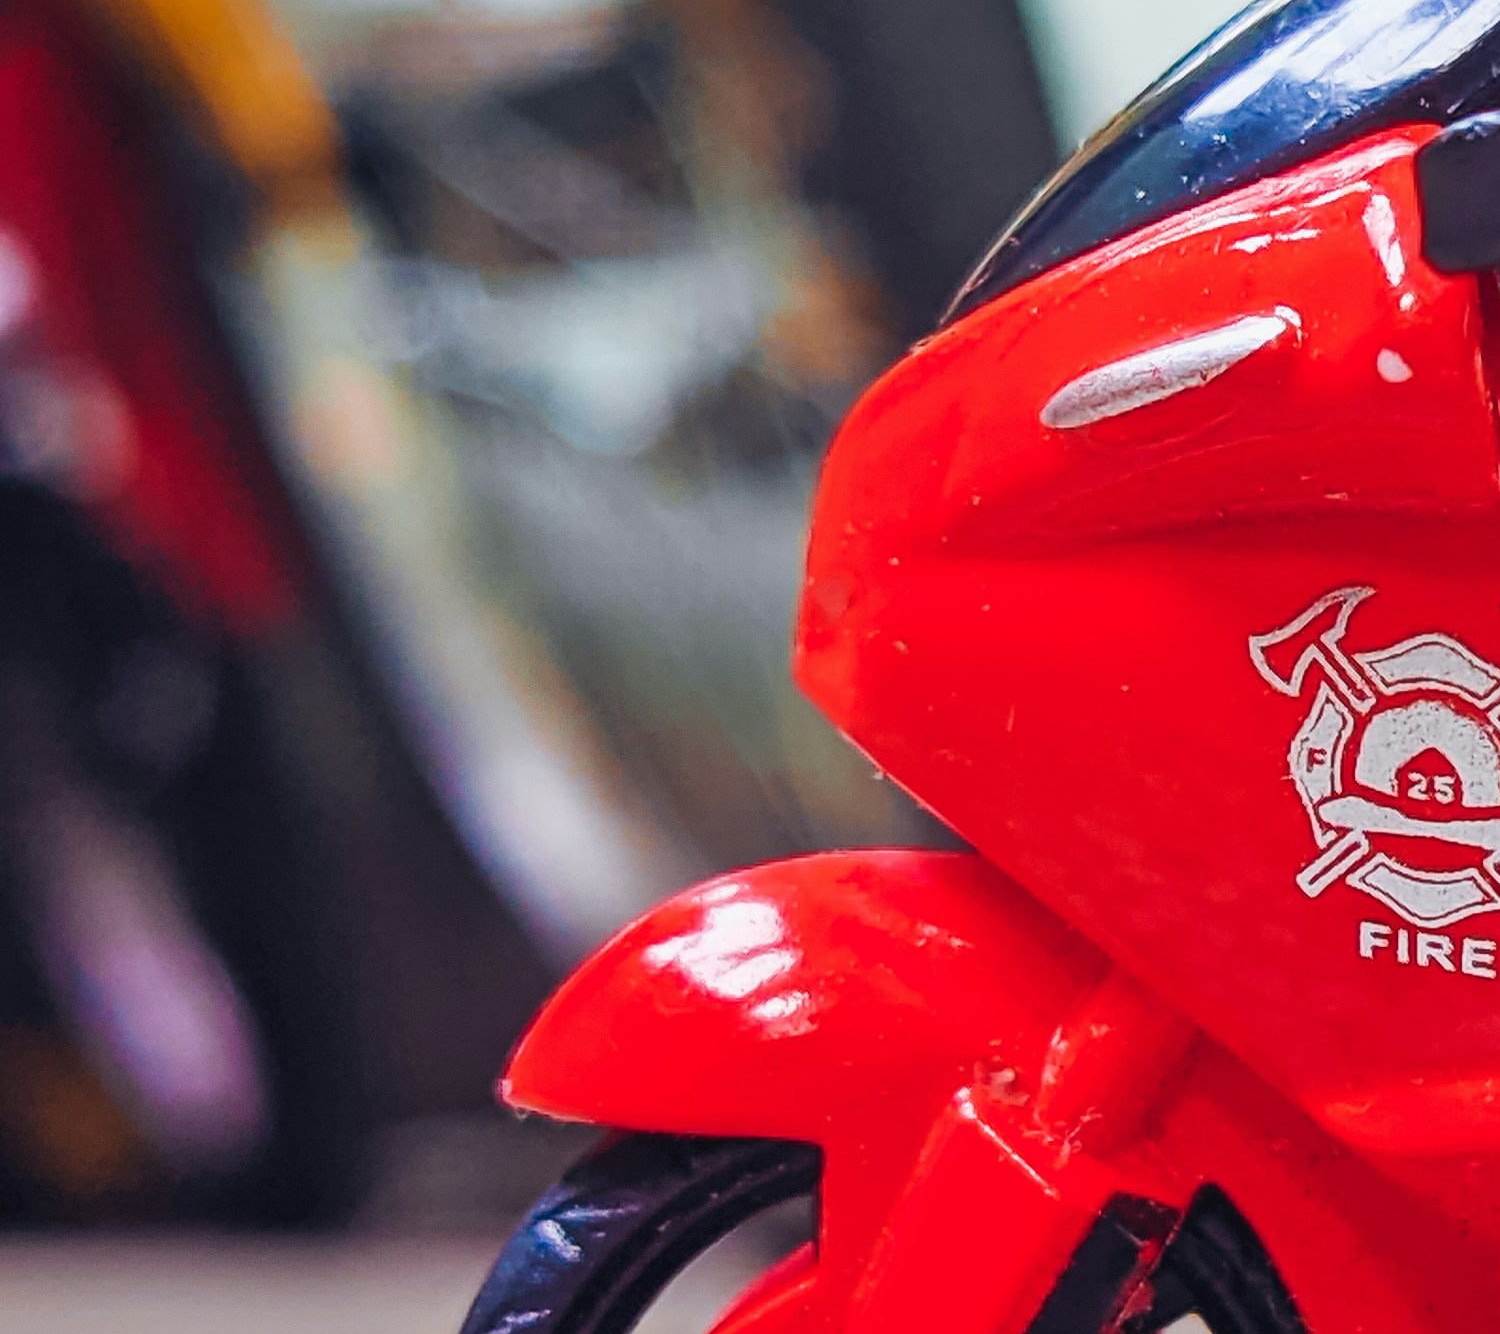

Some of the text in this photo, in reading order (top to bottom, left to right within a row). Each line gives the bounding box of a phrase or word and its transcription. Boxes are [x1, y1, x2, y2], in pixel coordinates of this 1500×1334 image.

[1306, 748, 1327, 772] F
[1407, 772, 1456, 805] 25
[1359, 921, 1497, 979] FIRE
